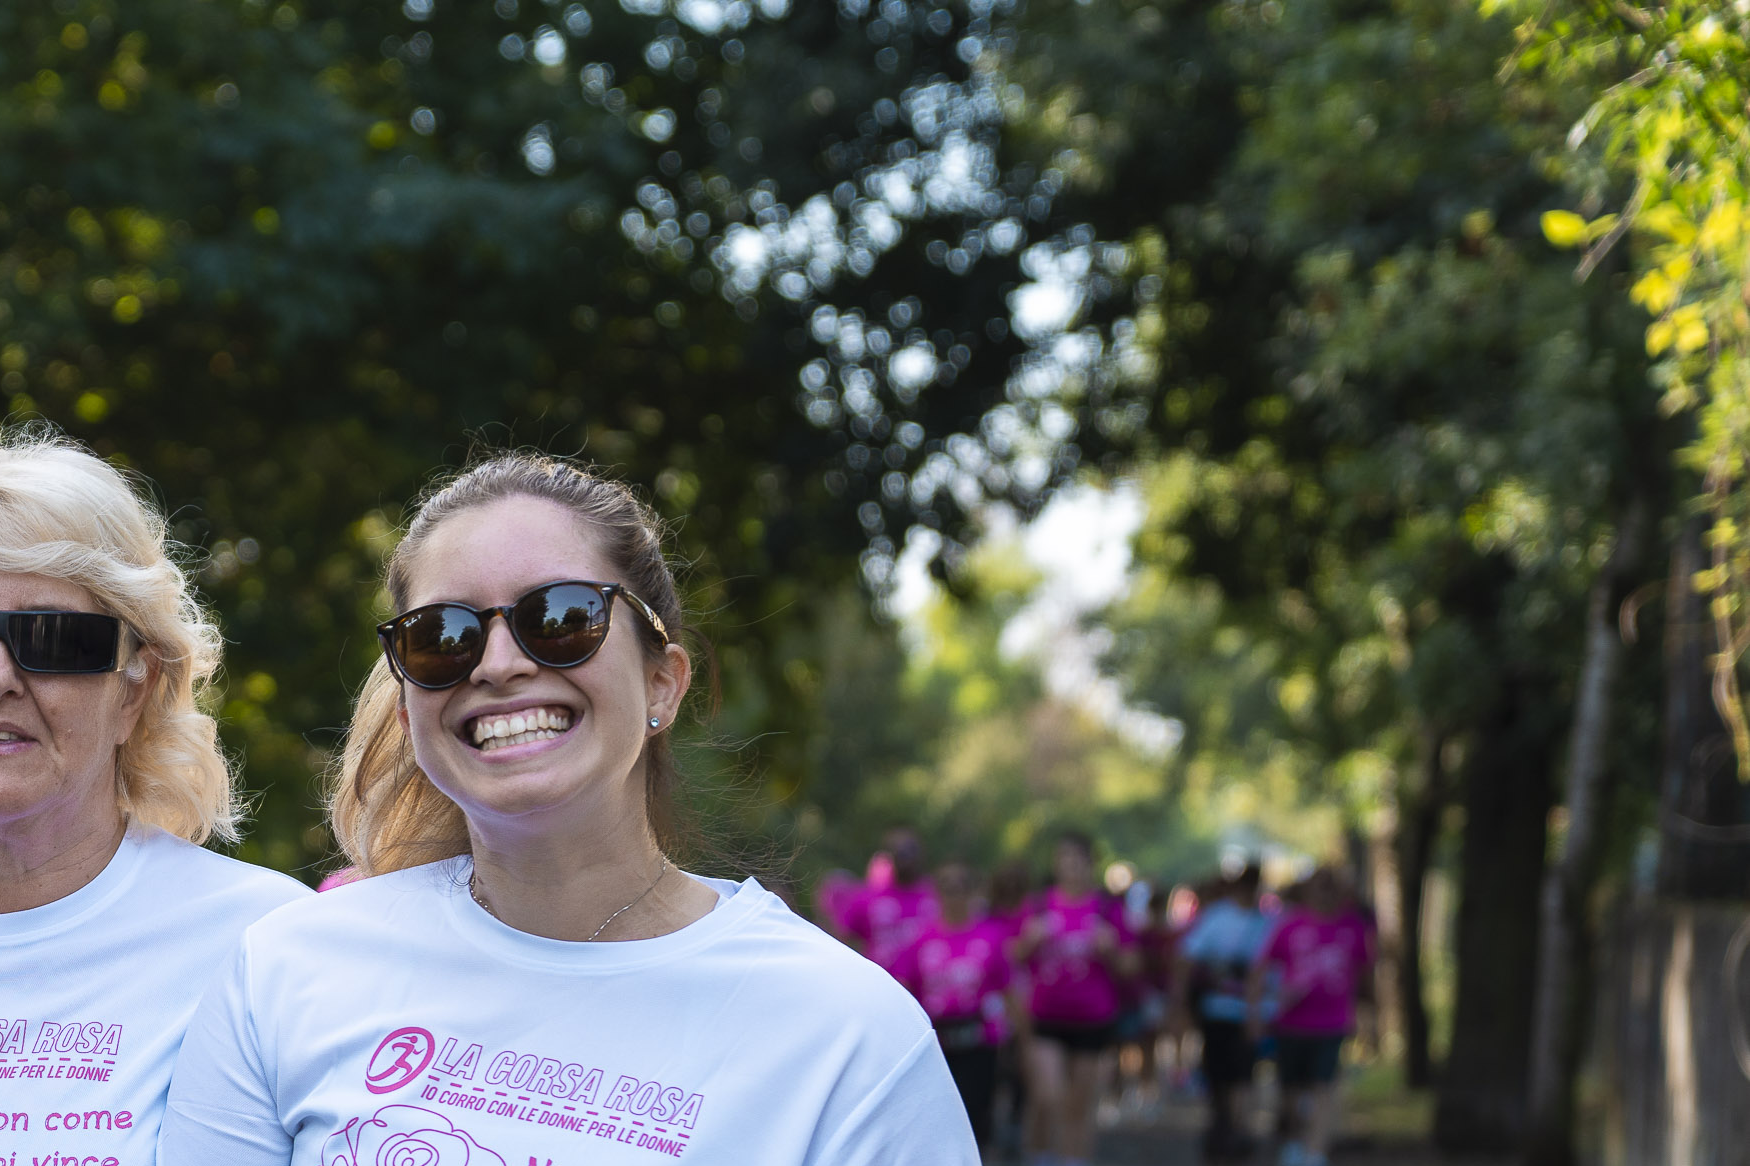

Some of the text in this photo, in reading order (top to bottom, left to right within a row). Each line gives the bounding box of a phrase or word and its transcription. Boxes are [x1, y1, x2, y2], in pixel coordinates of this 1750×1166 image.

[33, 1022, 122, 1055] ROSA
[20, 1065, 46, 1079] PER
[47, 1065, 64, 1079] LE
[66, 1066, 113, 1082] DONNE
[433, 1037, 705, 1130] LA CORSA ROSA
[45, 1110, 133, 1131] come
[421, 1084, 687, 1158] IO CORRO CON LE DONNE PER LE DONNE
